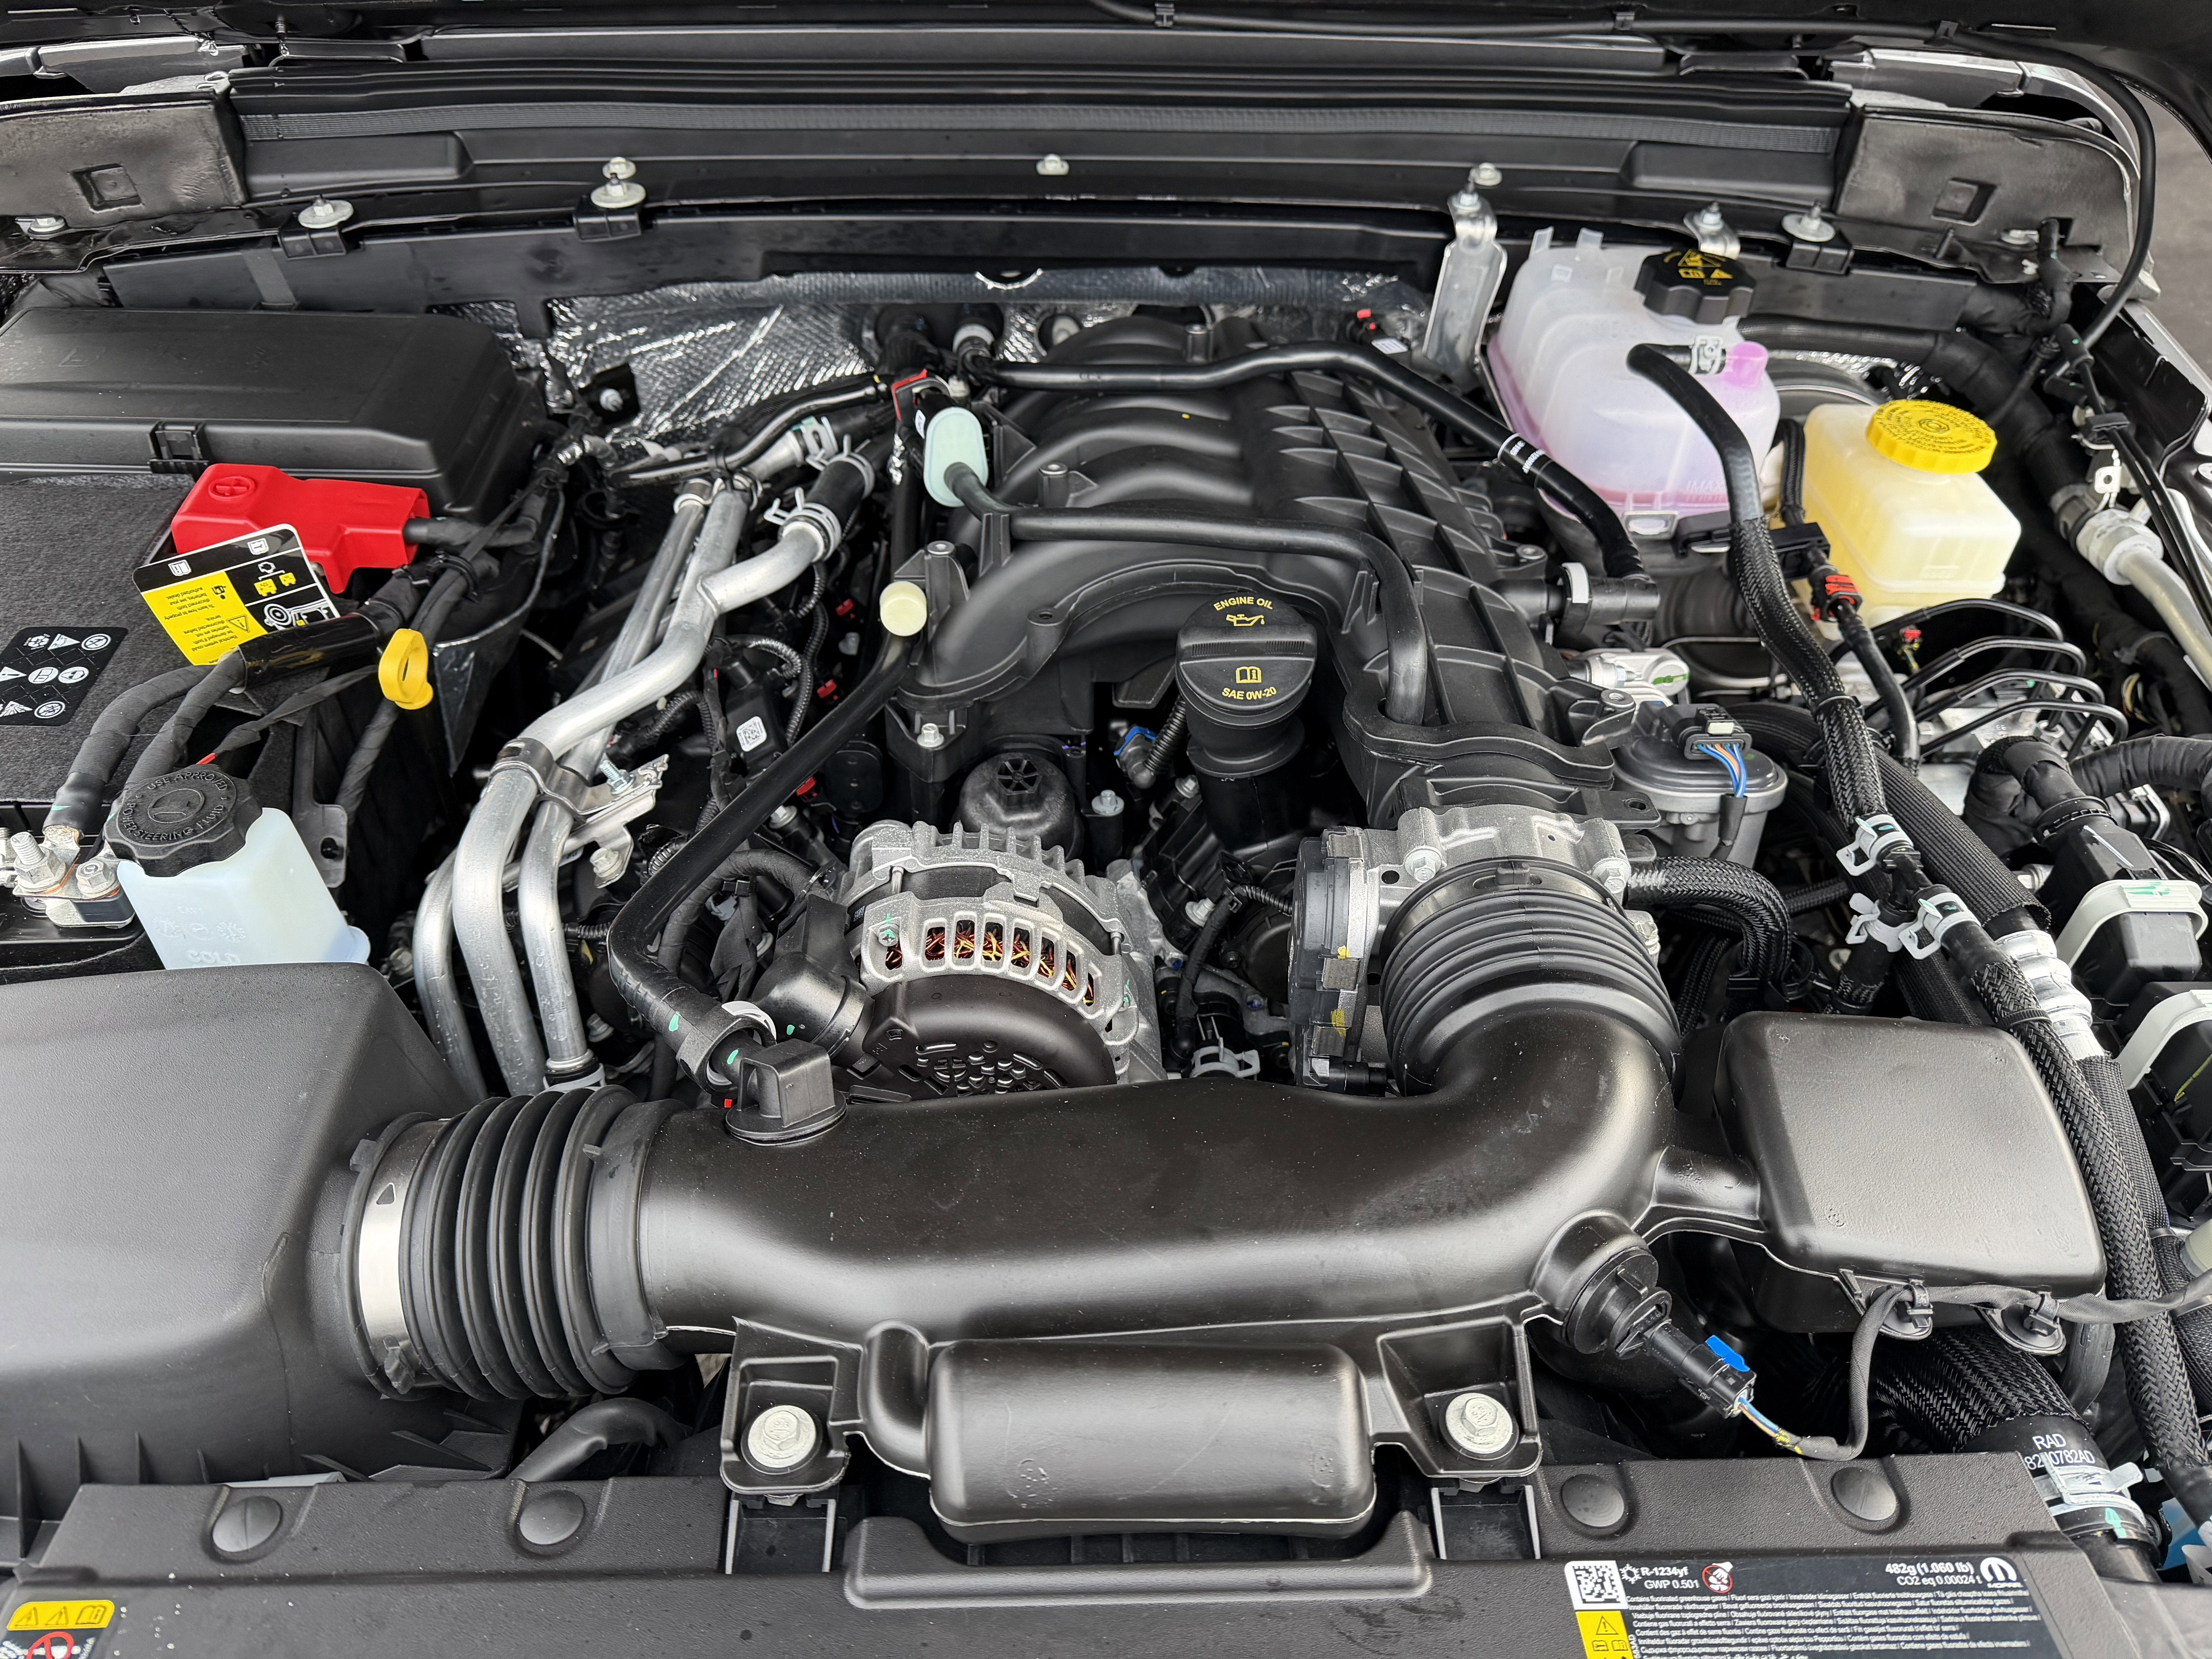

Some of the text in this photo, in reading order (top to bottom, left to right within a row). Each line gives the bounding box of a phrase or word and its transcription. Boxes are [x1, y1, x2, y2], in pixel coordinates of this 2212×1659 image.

[1214, 597, 1273, 611] ENGINE OIL
[164, 612, 182, 620] properly
[197, 620, 224, 630] disconnected
[208, 631, 227, 640] damaged
[218, 634, 238, 643] Electrical
[1222, 687, 1277, 700] SAE 0W-20
[147, 771, 228, 790] USE APPROVED
[122, 803, 224, 841] POWER STEERING FLUID
[186, 949, 241, 965] COLD
[2032, 1434, 2066, 1450] RAD
[2024, 1449, 2095, 1470] 820782AD
[1642, 1566, 1688, 1578] R-1234yf
[1886, 1561, 1974, 1576] 482g (1.060 lb)
[1644, 1579, 1700, 1589] GWP 0.501
[1897, 1575, 1983, 1587] CO2 eq 0.00024 t
